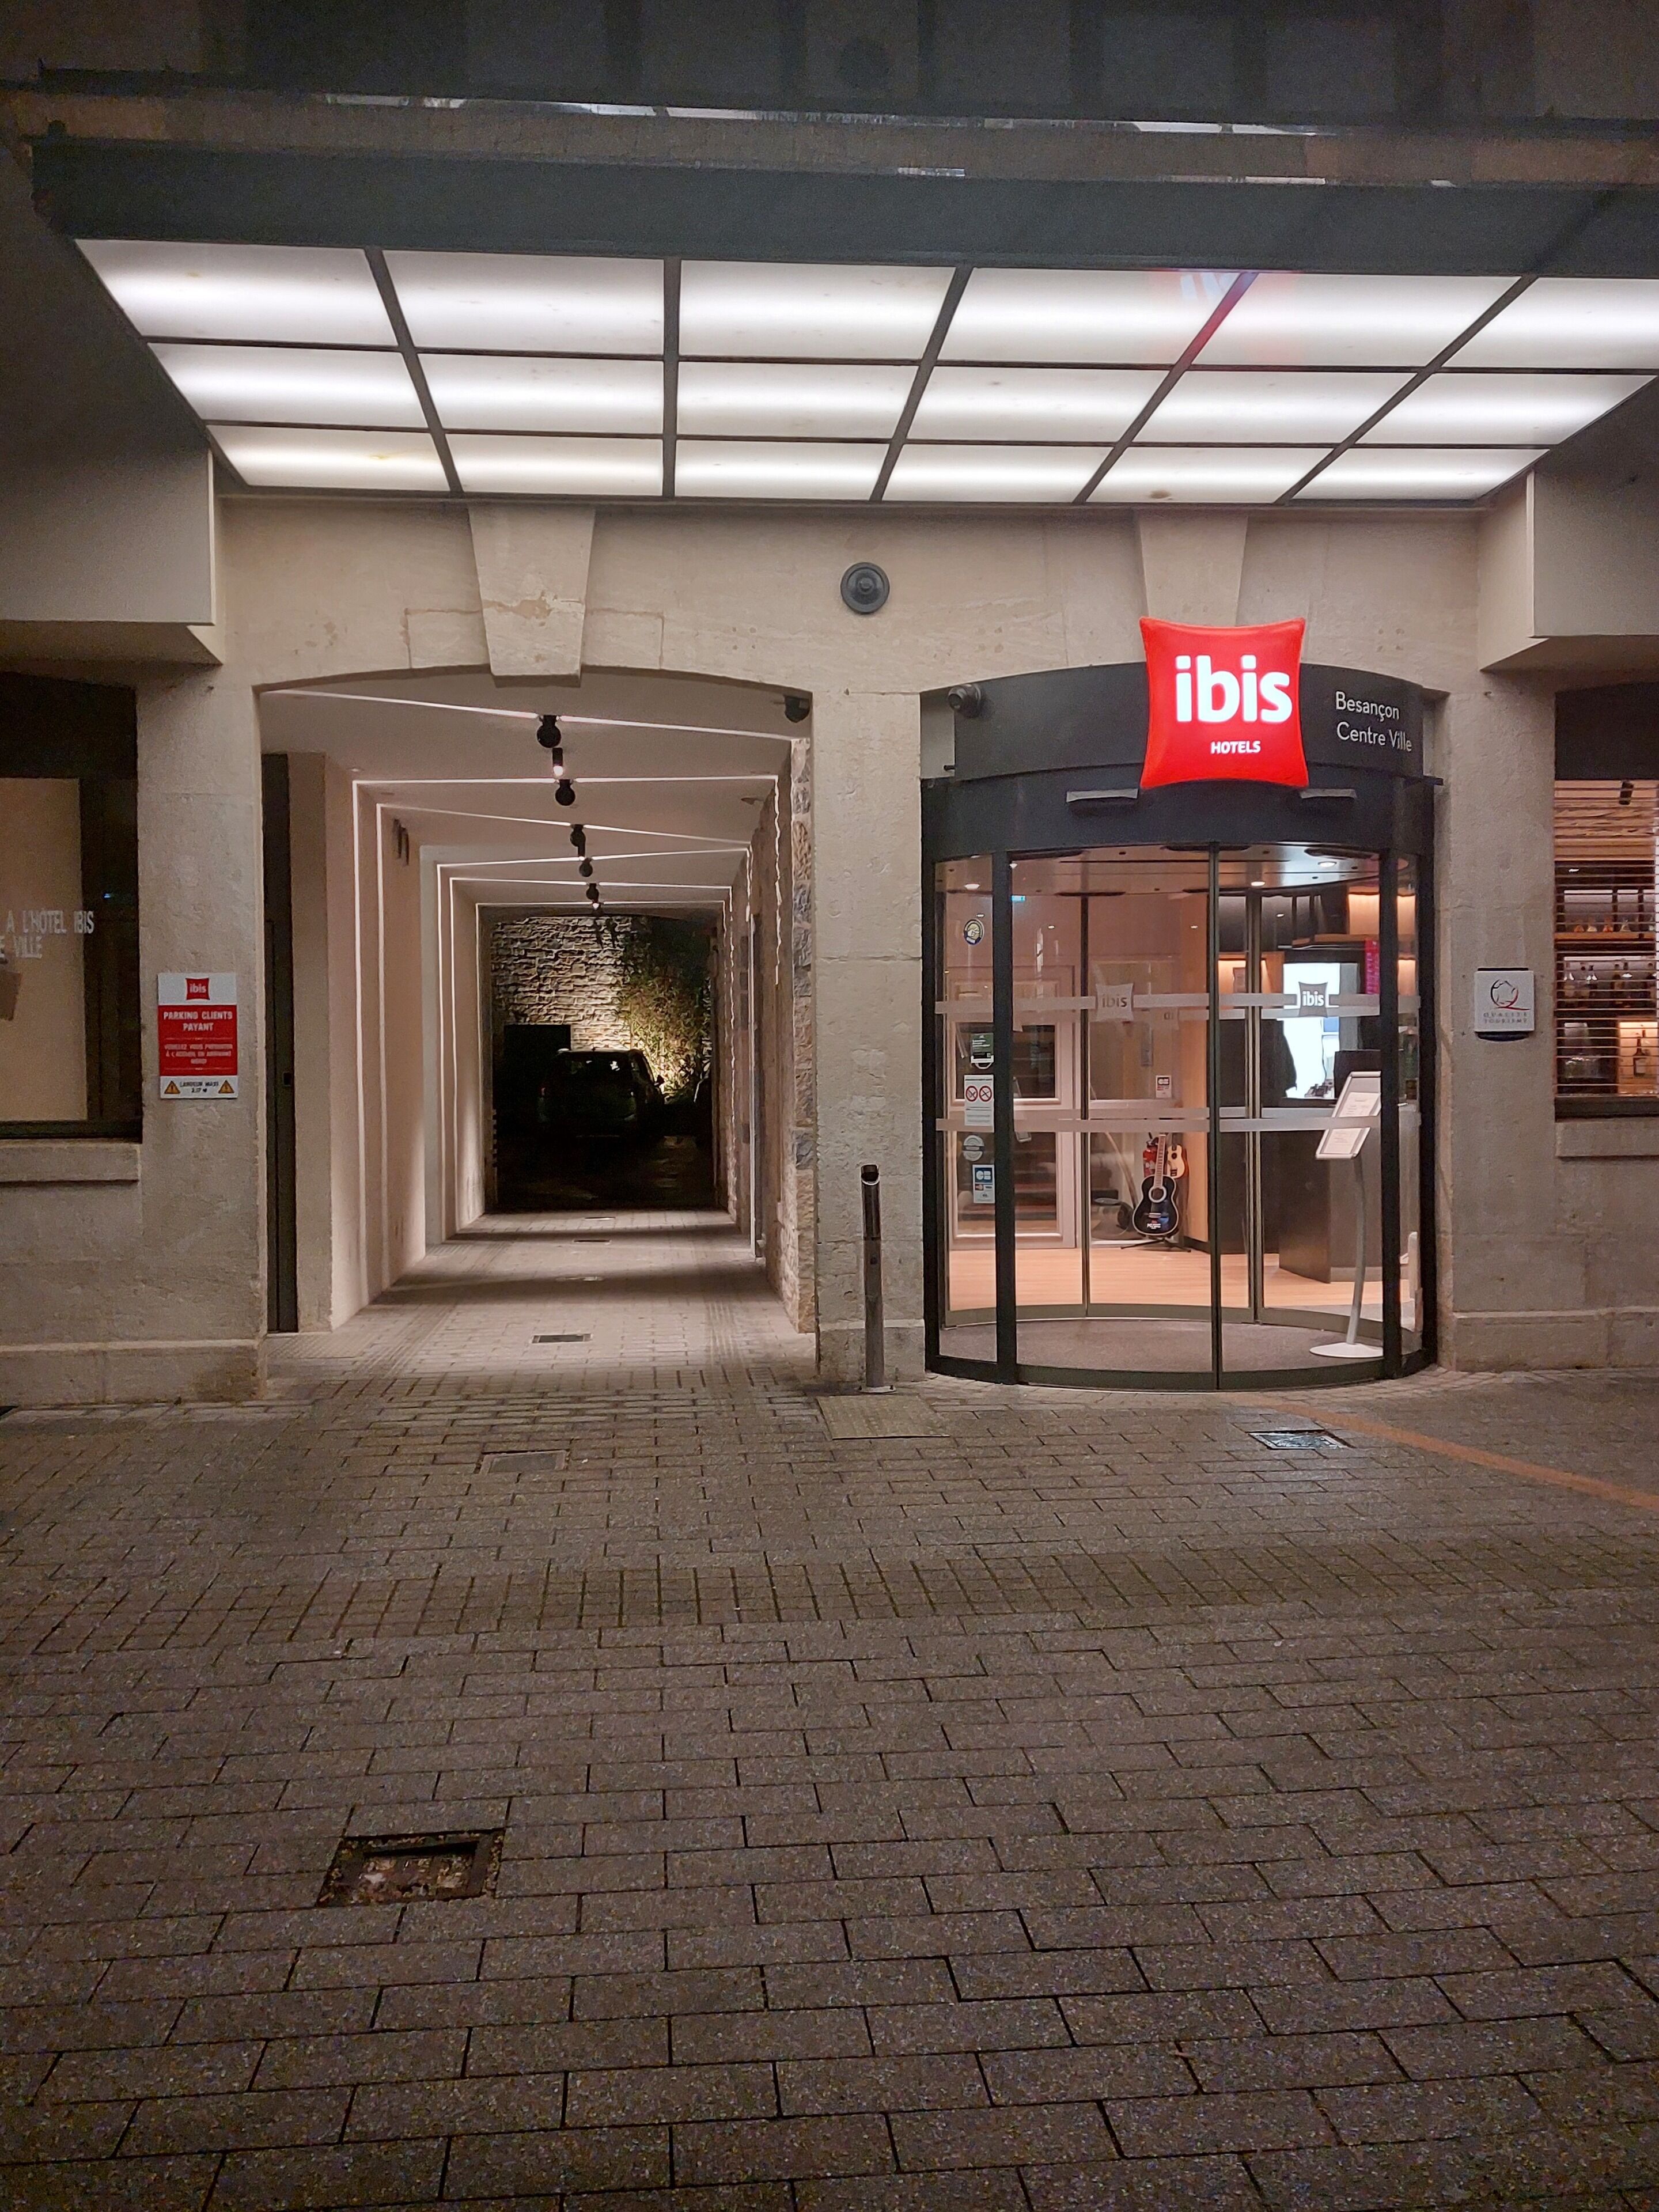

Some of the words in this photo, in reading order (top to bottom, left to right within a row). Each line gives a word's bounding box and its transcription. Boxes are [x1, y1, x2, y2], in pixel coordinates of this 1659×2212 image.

[1175, 654, 1293, 724] ibis
[1335, 691, 1400, 722] Besançon
[1336, 721, 1386, 747] Centre
[1388, 728, 1412, 752] Ville
[1210, 740, 1261, 755] HOTELS
[73, 910, 95, 934] IBIS
[189, 983, 207, 994] ibis
[1101, 994, 1128, 1008] ibis
[1302, 990, 1324, 1007] ibis
[163, 1010, 199, 1020] PARKING
[201, 1010, 233, 1020] CLIENTS
[182, 1022, 214, 1032] PAYANT
